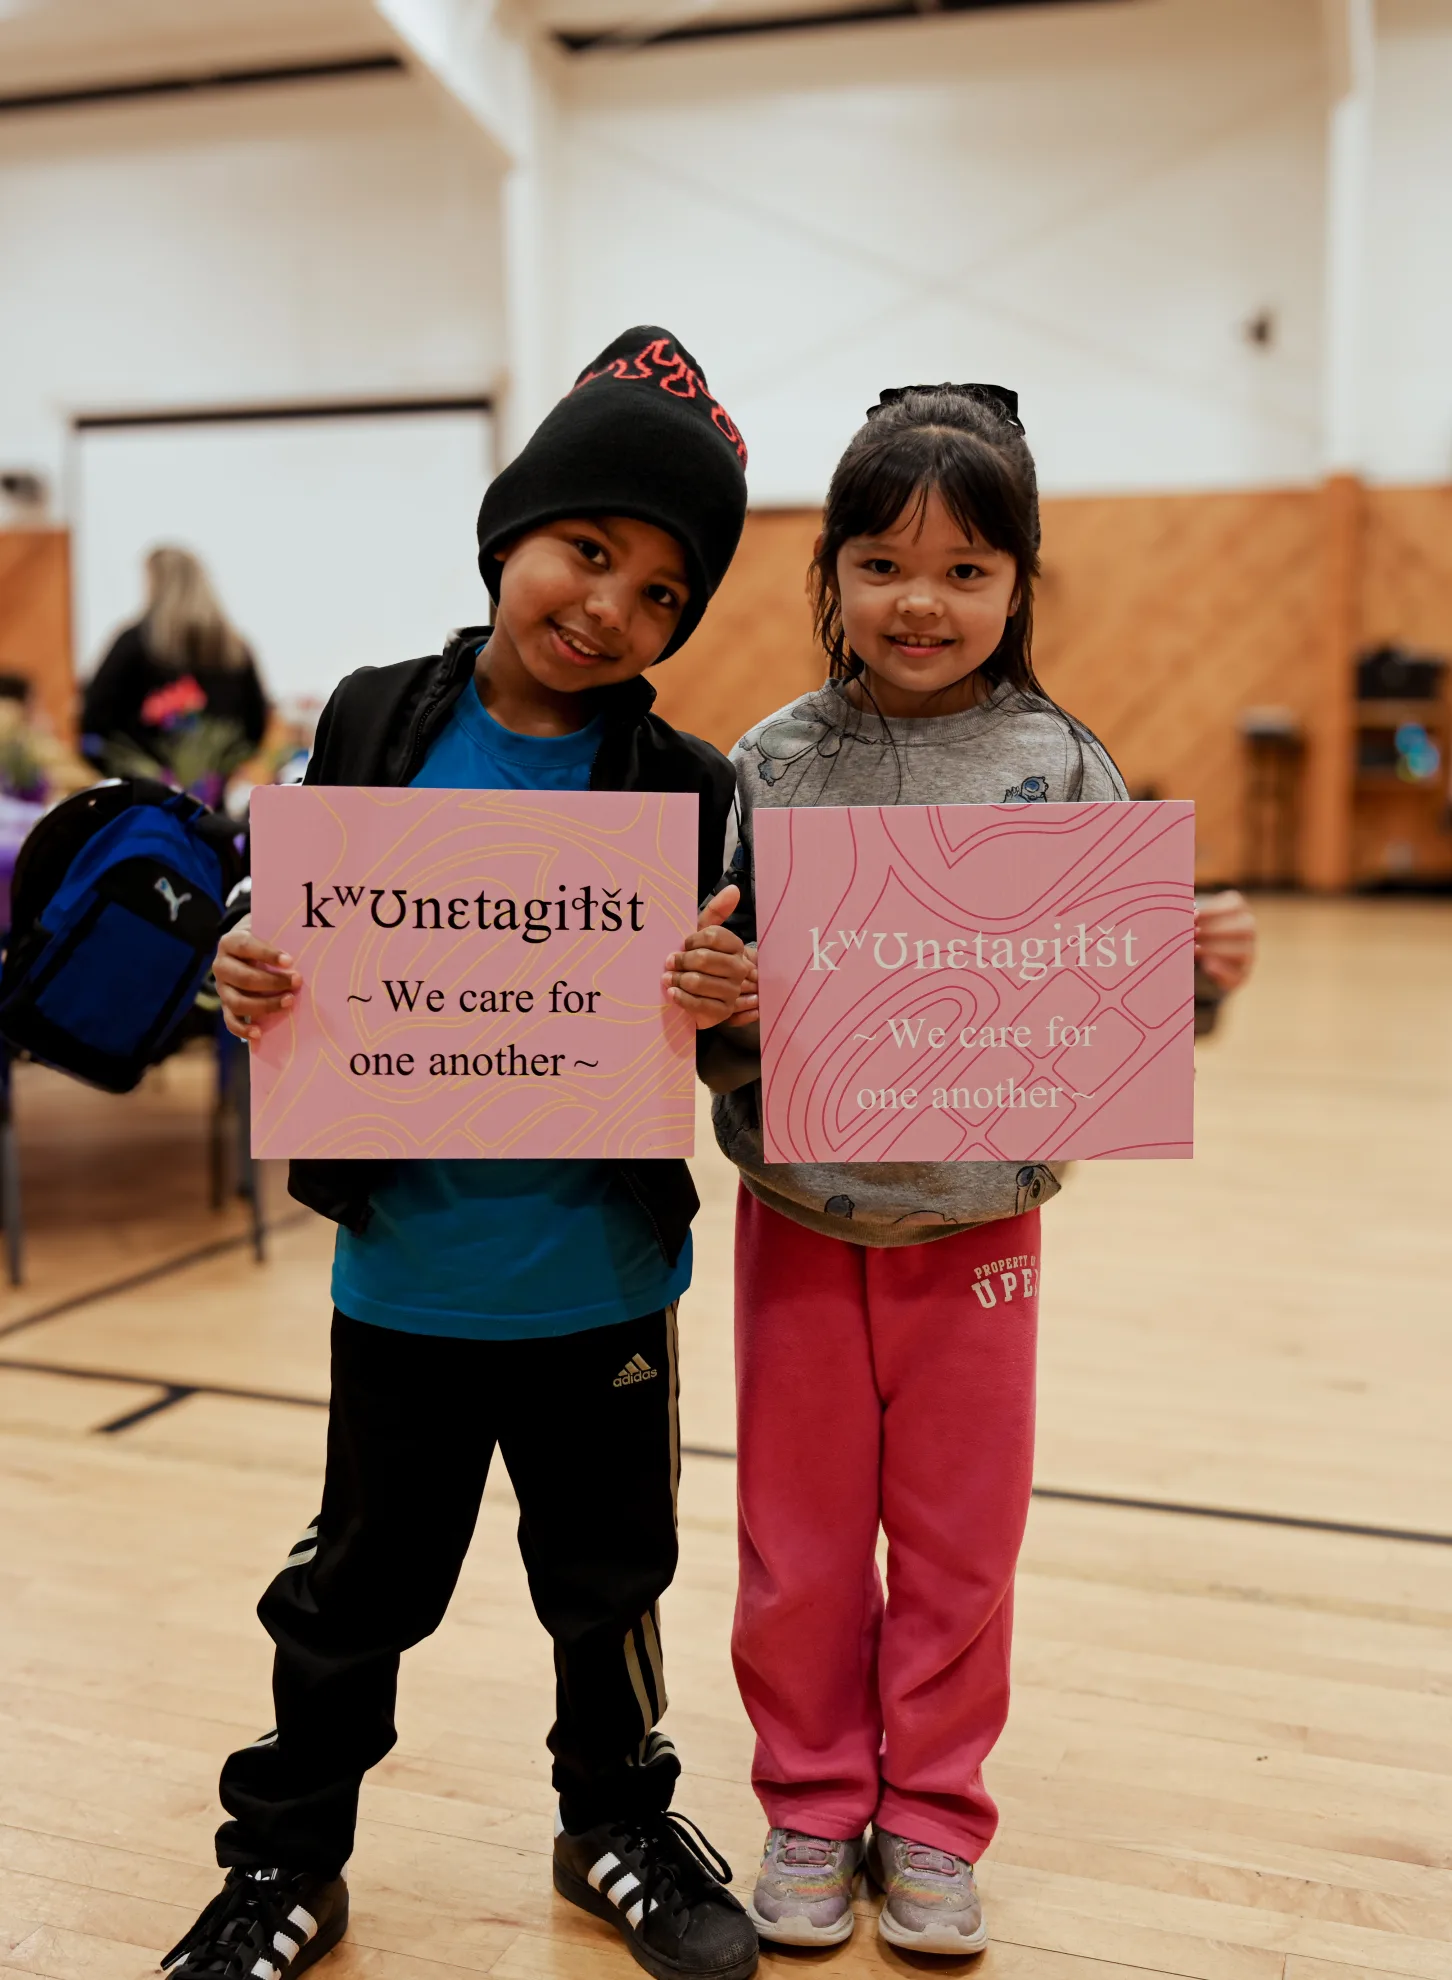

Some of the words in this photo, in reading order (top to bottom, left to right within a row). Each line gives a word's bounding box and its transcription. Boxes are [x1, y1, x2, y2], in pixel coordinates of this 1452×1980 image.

[382, 980, 445, 1013] We
[459, 990, 534, 1014] care
[548, 980, 602, 1014] for
[887, 1018, 946, 1049] We
[959, 1025, 1032, 1049] care
[1046, 1016, 1097, 1047] for
[349, 1053, 415, 1077] one
[429, 1043, 566, 1077] another
[856, 1087, 918, 1110] one
[932, 1078, 1063, 1110] another
[974, 1255, 1028, 1279] PROPERTY
[613, 1369, 658, 1387] adidas
